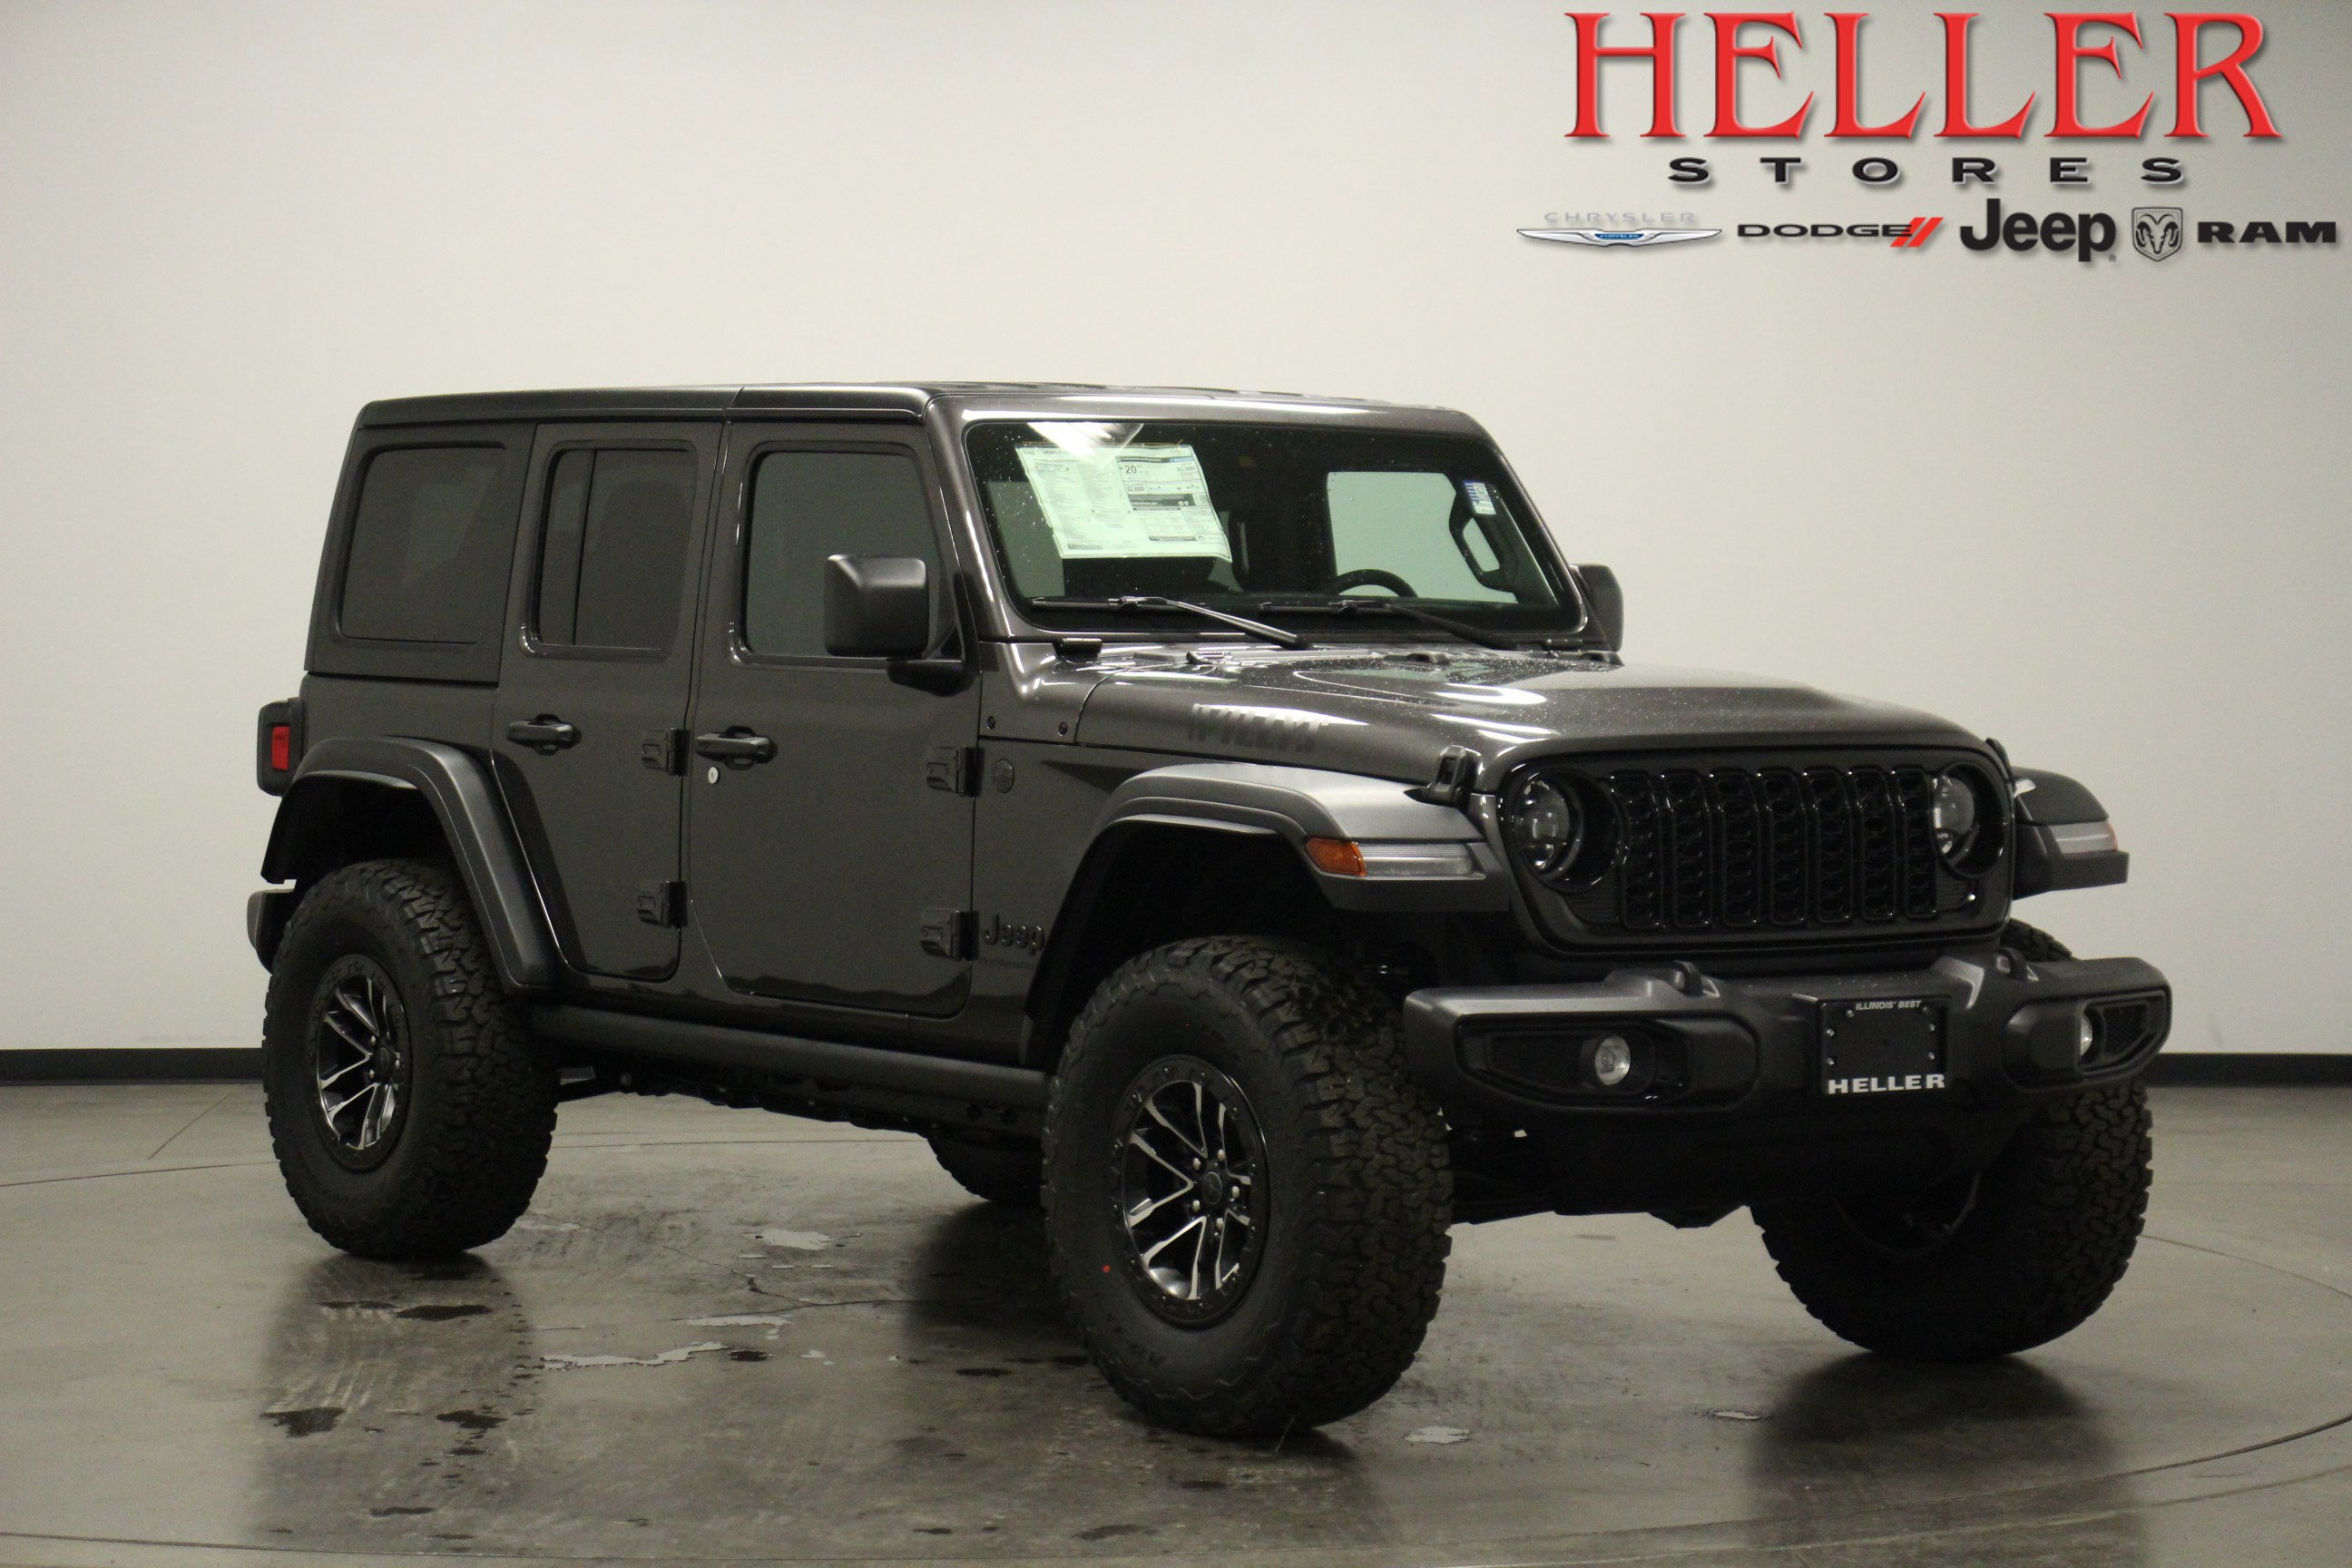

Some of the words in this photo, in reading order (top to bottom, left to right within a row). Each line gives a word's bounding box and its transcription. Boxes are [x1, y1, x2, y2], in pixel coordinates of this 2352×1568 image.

[983, 914, 1046, 956] Jeep
[1898, 1000, 1922, 1008] BEST
[1828, 1073, 1945, 1094] HELLER
